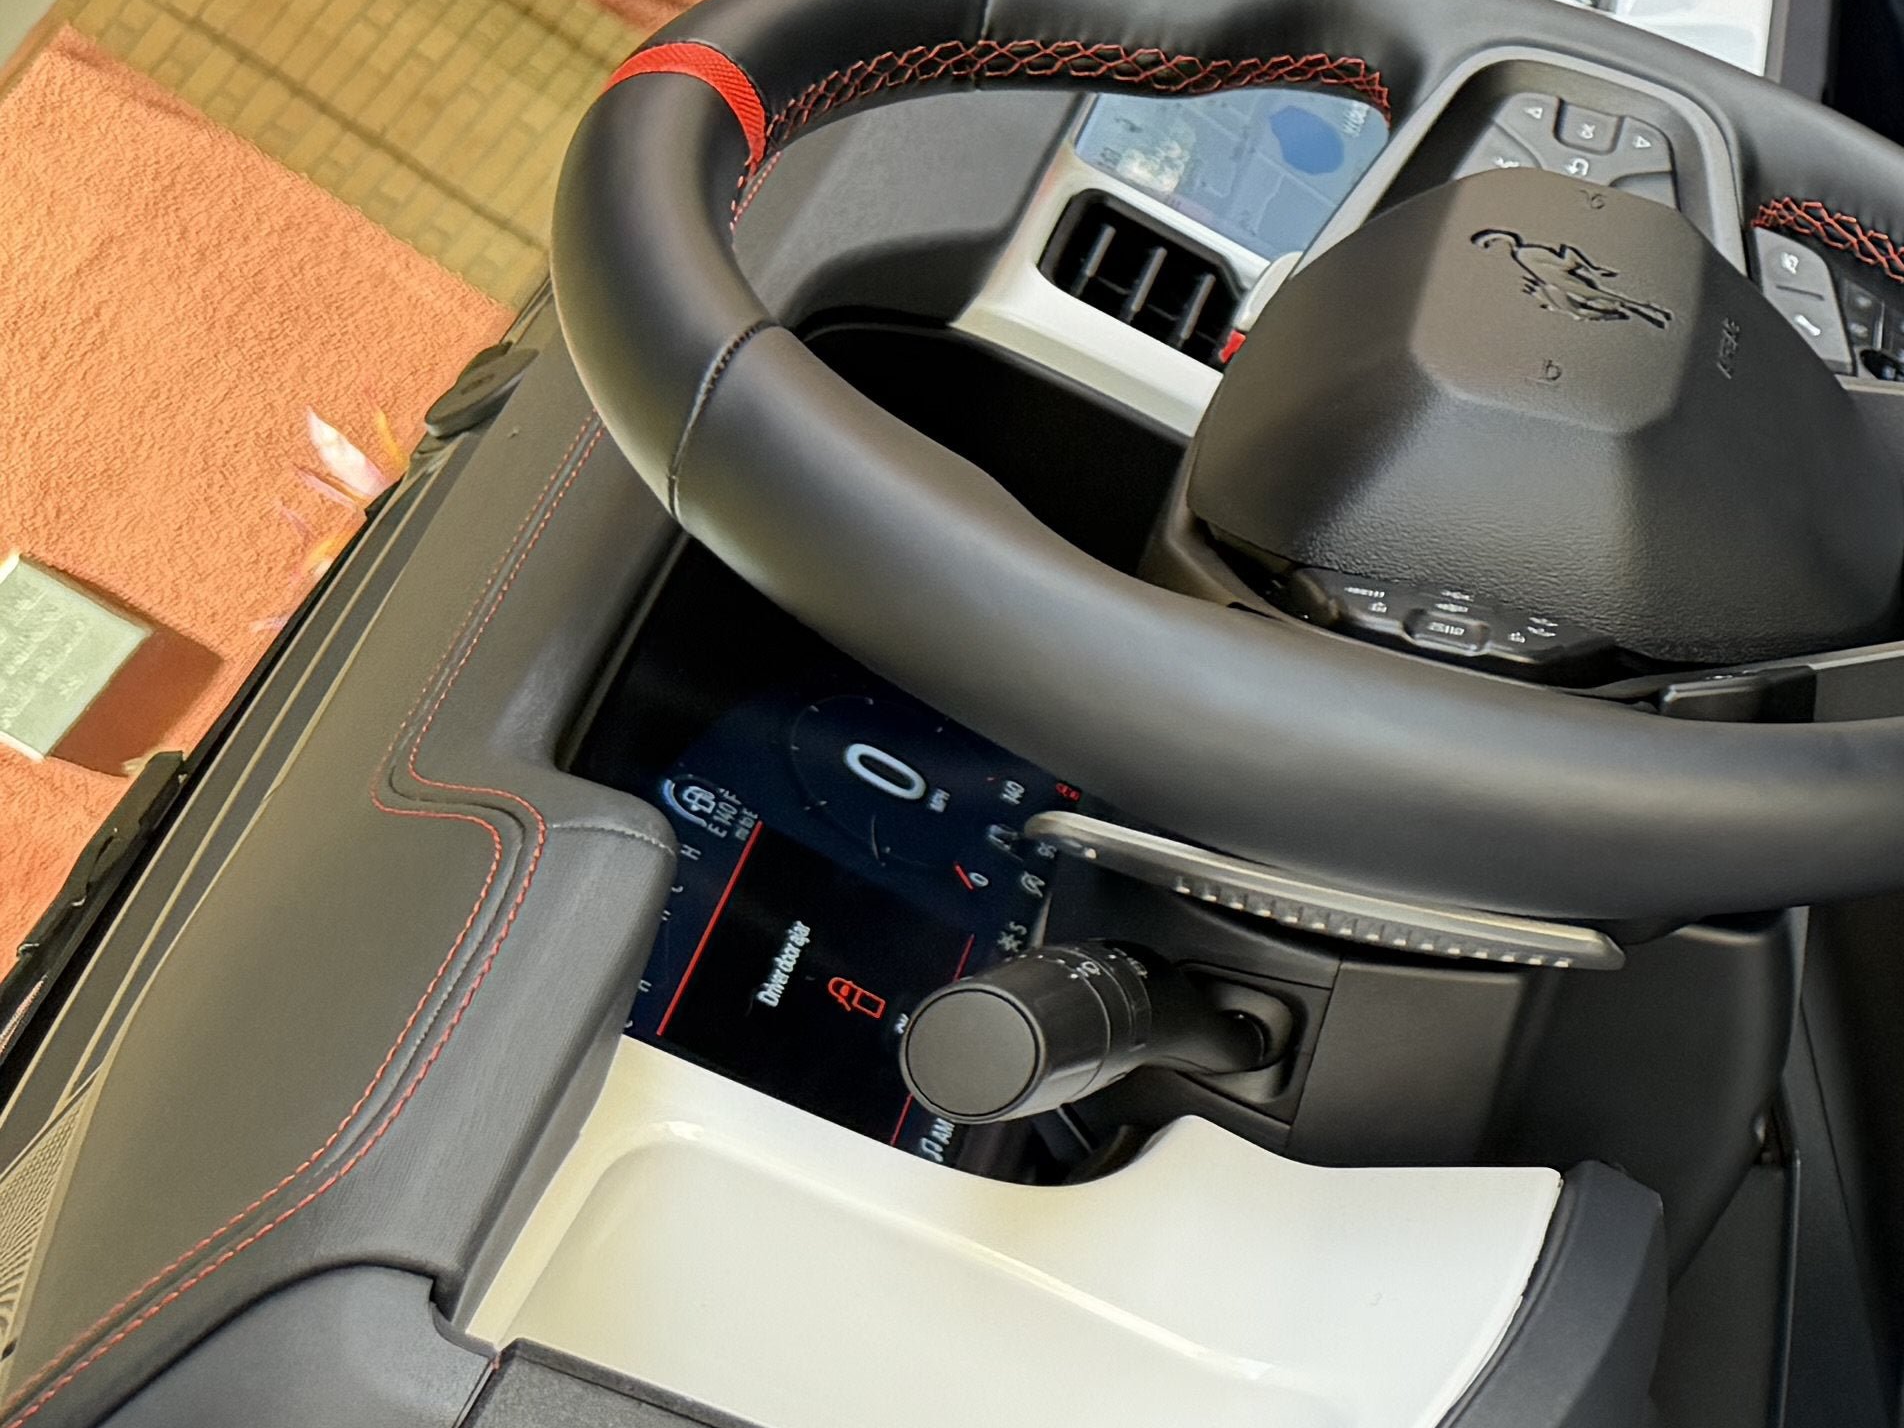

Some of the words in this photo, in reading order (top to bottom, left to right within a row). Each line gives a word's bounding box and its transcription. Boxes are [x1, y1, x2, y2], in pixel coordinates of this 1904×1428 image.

[843, 740, 928, 803] 0
[708, 822, 729, 839] E
[714, 800, 739, 827] 140
[756, 968, 790, 1007] Driver
[773, 942, 801, 973] door
[787, 920, 811, 947] ajar
